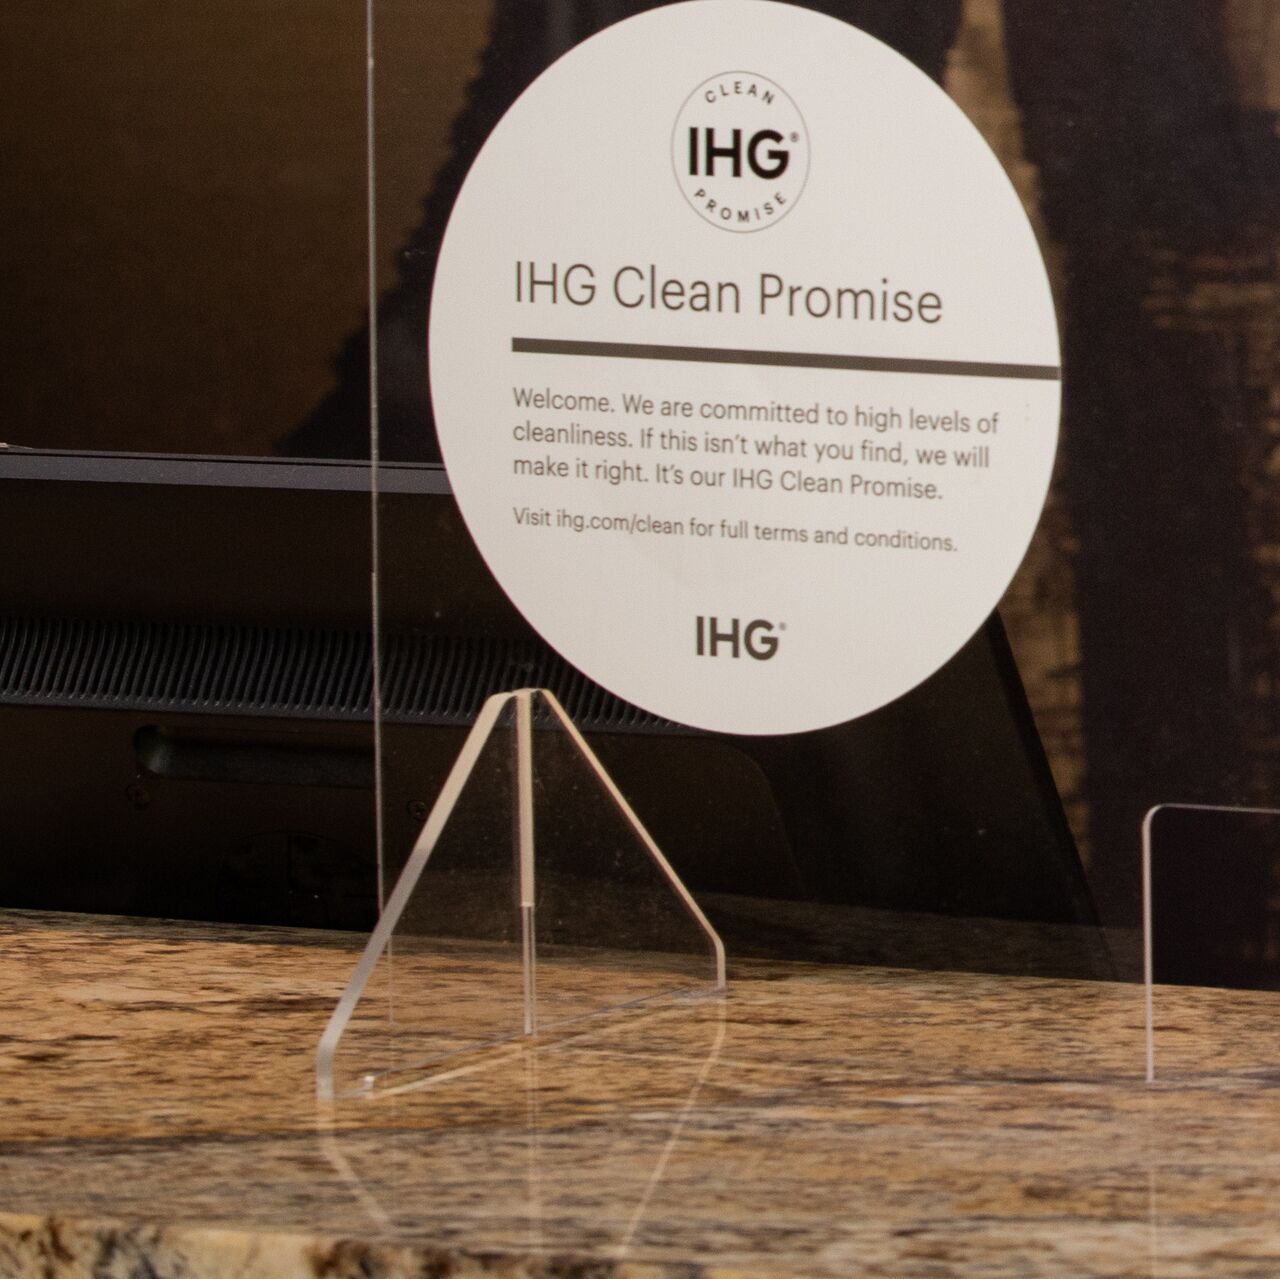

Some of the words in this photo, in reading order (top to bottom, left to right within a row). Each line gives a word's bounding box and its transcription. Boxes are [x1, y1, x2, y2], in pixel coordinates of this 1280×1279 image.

[703, 82, 776, 106] CLEAN
[694, 188, 788, 223] PROMISE
[517, 261, 595, 306] IHG
[614, 265, 739, 313] Clean
[760, 273, 942, 323] Promise
[513, 387, 614, 412] Welcome.
[622, 394, 654, 415] We
[661, 401, 693, 417] are
[700, 401, 819, 424] committed
[826, 407, 848, 426] to
[855, 405, 902, 433] high
[910, 408, 970, 432] levels
[977, 412, 999, 434] of
[513, 420, 632, 447] cleanliness.
[641, 427, 653, 448] If
[660, 429, 697, 451] this
[705, 432, 747, 454] isn't
[755, 435, 807, 458] what
[814, 444, 853, 463] you
[861, 439, 908, 466] find,
[916, 450, 946, 465] we
[953, 446, 989, 468] will
[514, 456, 569, 477] make
[576, 461, 588, 478] it
[595, 460, 648, 485] right.
[656, 464, 684, 484] It's
[690, 470, 726, 486] our
[733, 468, 773, 490] IHG
[780, 470, 842, 493] Clean
[851, 474, 942, 499] Promise.
[513, 507, 550, 526] Visit
[557, 509, 684, 534] ihg.com/clean
[690, 517, 714, 536] for
[720, 519, 748, 538] full
[754, 525, 808, 542] terms
[814, 527, 848, 545] and
[854, 530, 957, 551] conditions.
